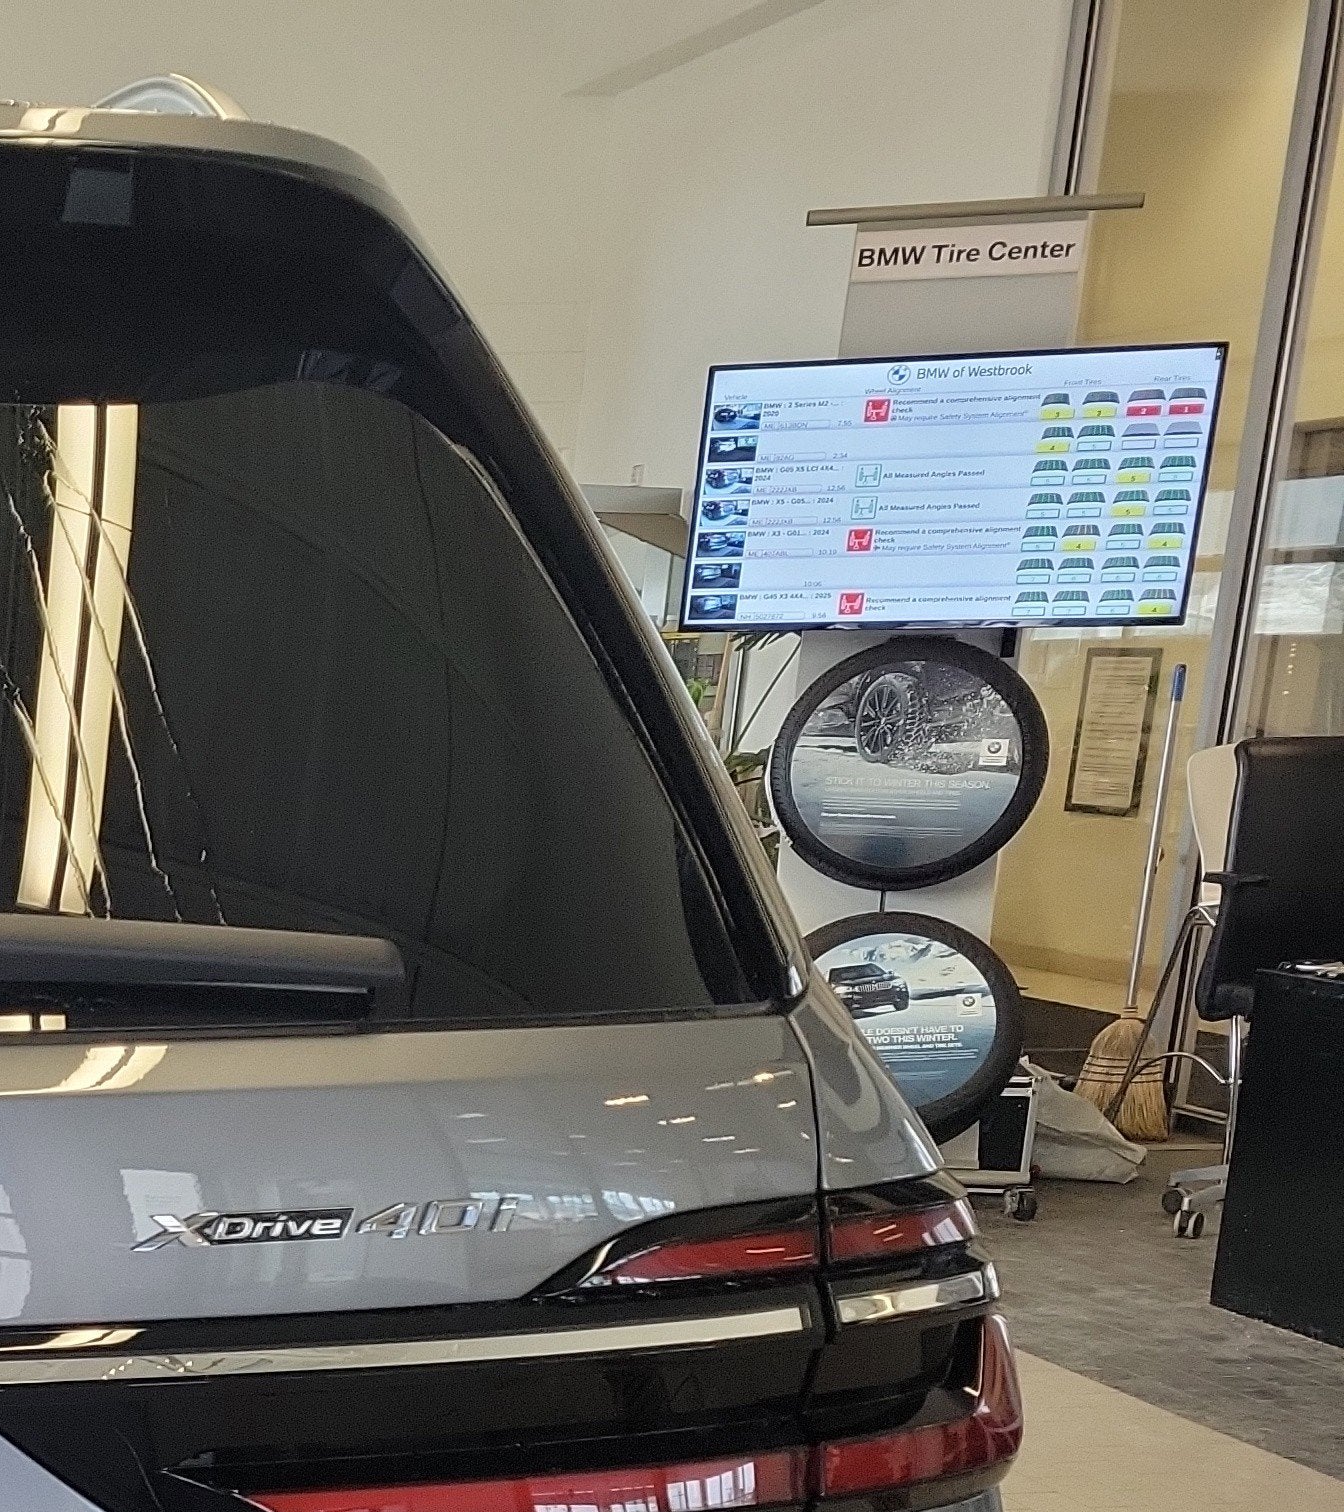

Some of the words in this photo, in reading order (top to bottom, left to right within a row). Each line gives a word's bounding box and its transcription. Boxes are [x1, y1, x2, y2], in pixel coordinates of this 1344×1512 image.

[857, 246, 927, 268] BMW
[932, 243, 980, 263] Tire
[988, 241, 1076, 261] Center
[917, 367, 950, 379] BMW
[952, 367, 965, 378] of
[968, 364, 1033, 377] Westbrook
[946, 396, 1002, 404] comprehensive
[1004, 394, 1041, 402] alignment
[928, 527, 983, 535] comprehensive
[884, 779, 921, 788] WINTER
[926, 779, 945, 788] THIS
[876, 1027, 918, 1035] DOESN'T
[866, 1036, 890, 1044] TWO
